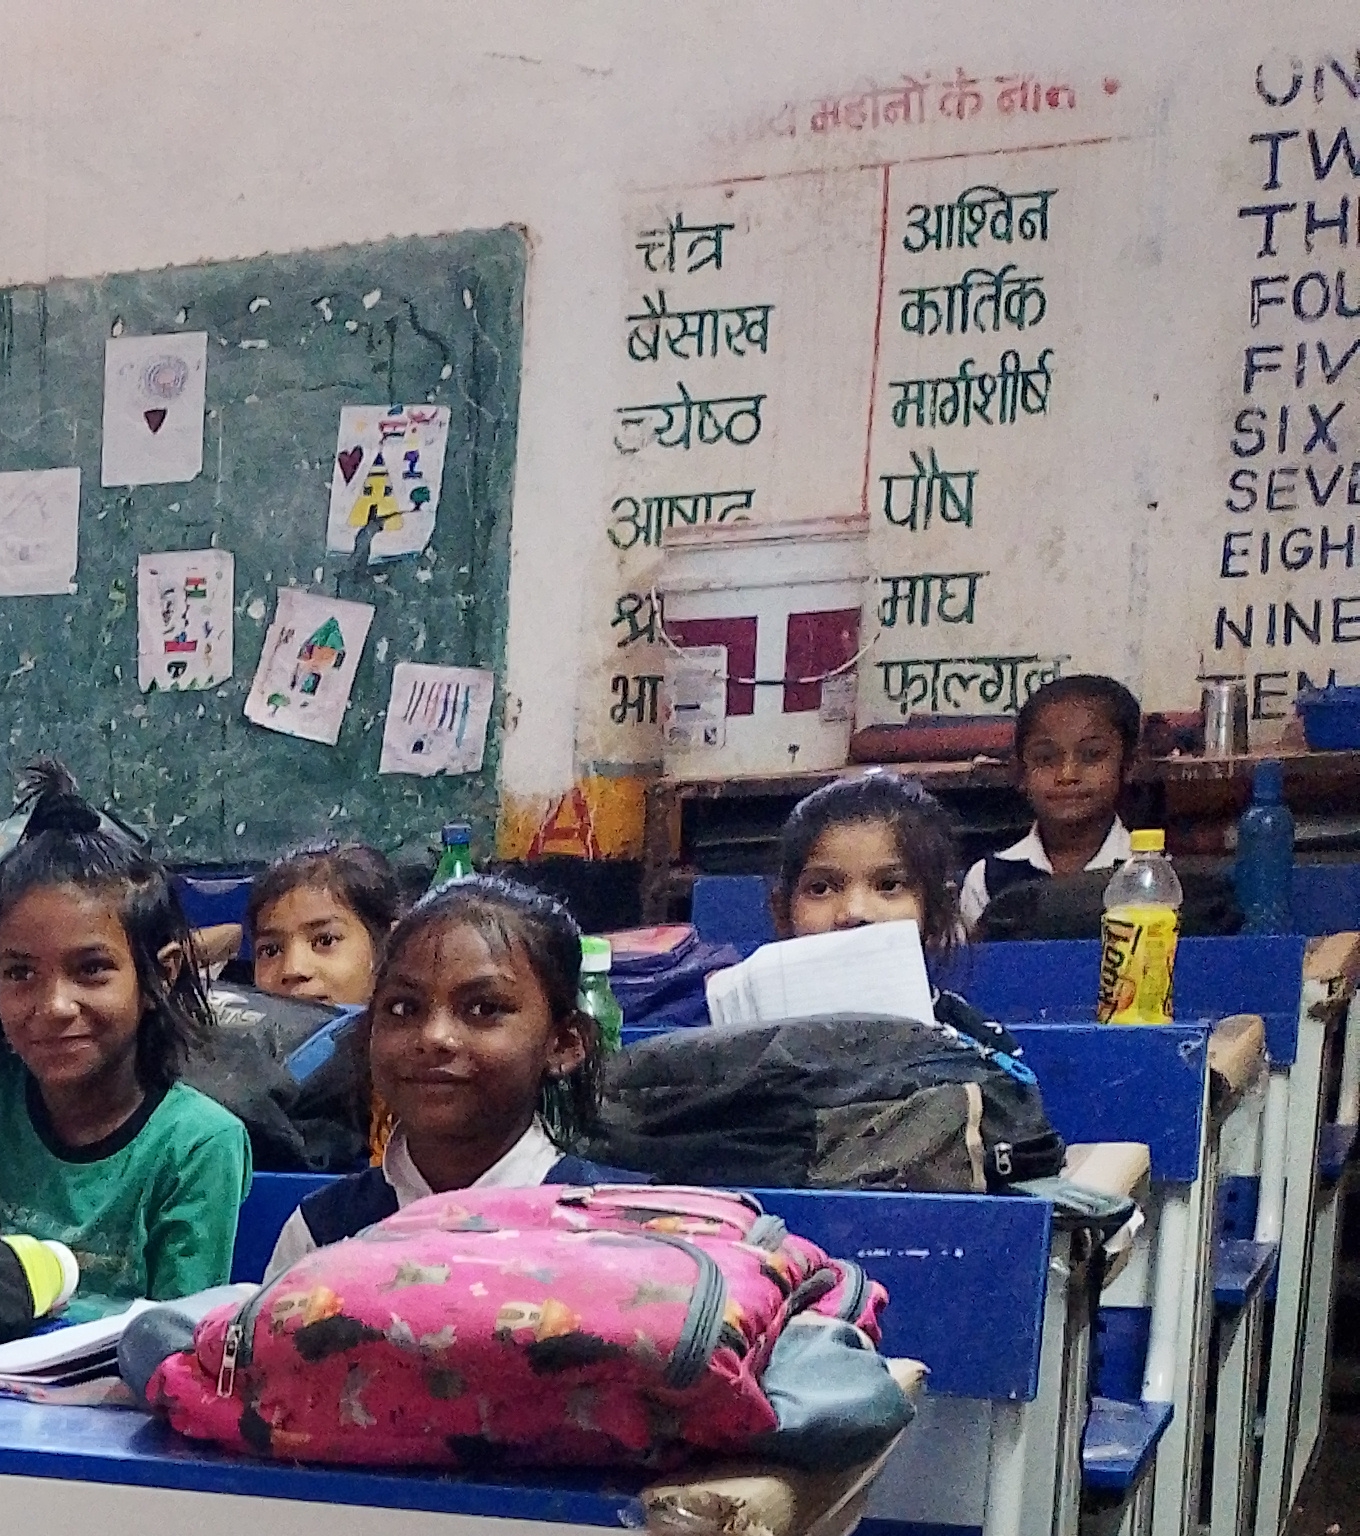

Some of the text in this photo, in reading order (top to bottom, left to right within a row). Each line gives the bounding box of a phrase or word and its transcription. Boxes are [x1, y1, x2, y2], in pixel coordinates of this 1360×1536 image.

[634, 212, 735, 275] चैत्र
[903, 185, 1058, 253] आश्विन
[627, 289, 775, 363] बैसाख
[899, 263, 1047, 337] कार्तिक
[889, 348, 1053, 427] मार्गशीर्ष
[1230, 401, 1344, 457] SIX
[881, 447, 979, 531] पौष
[880, 571, 990, 627] माघ
[1215, 596, 1360, 650] NINE
